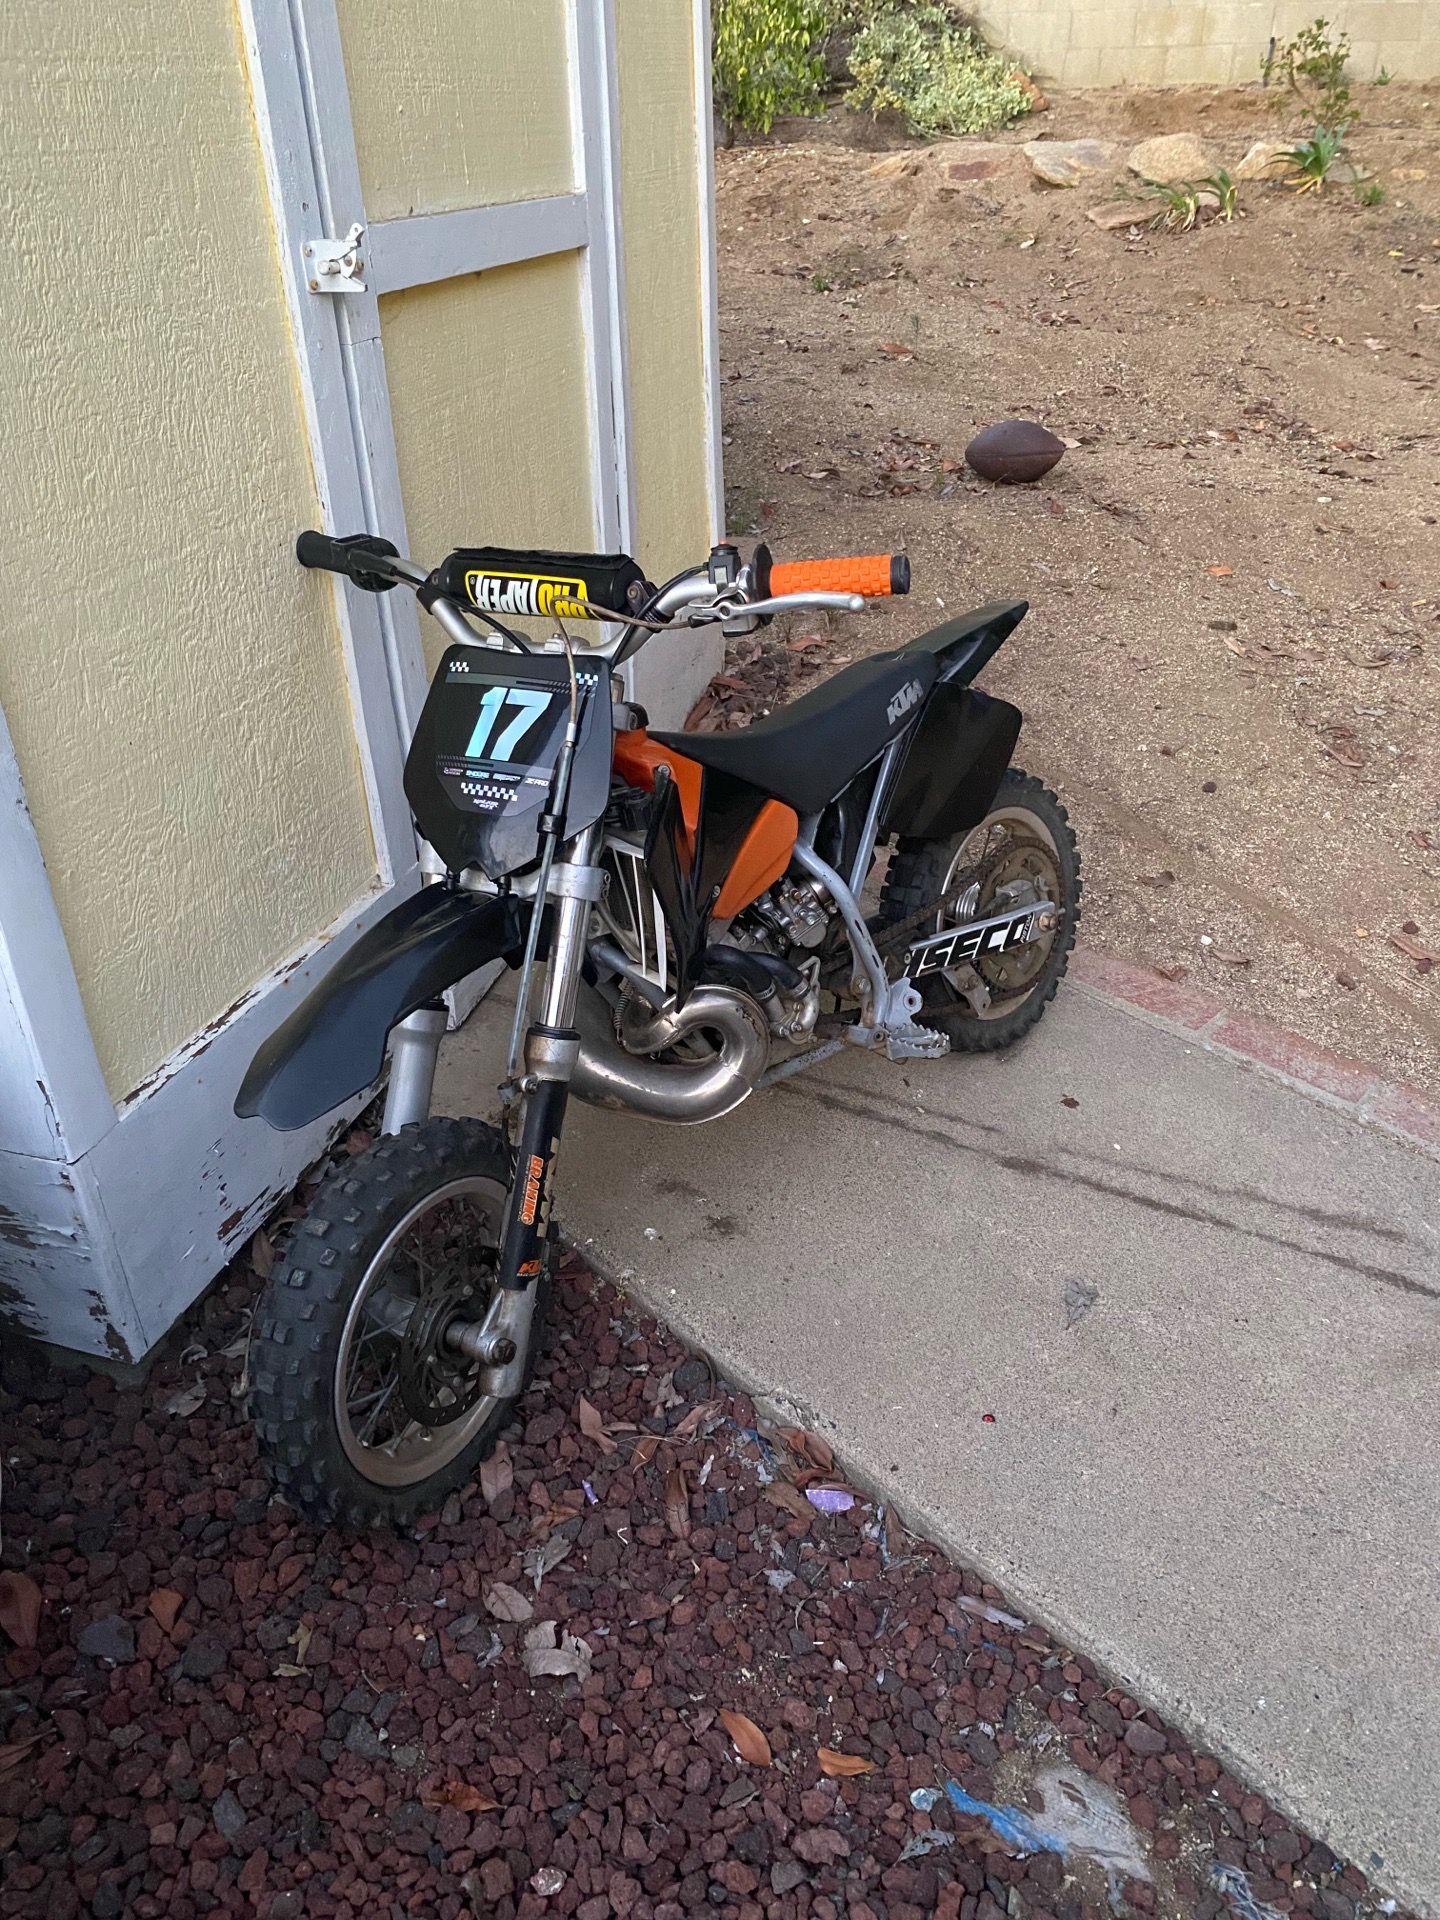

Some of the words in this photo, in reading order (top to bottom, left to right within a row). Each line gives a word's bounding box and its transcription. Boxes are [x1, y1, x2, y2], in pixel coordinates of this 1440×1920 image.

[465, 686, 553, 762] 17
[886, 678, 924, 726] KTM
[521, 1154, 544, 1226] BRAKING
